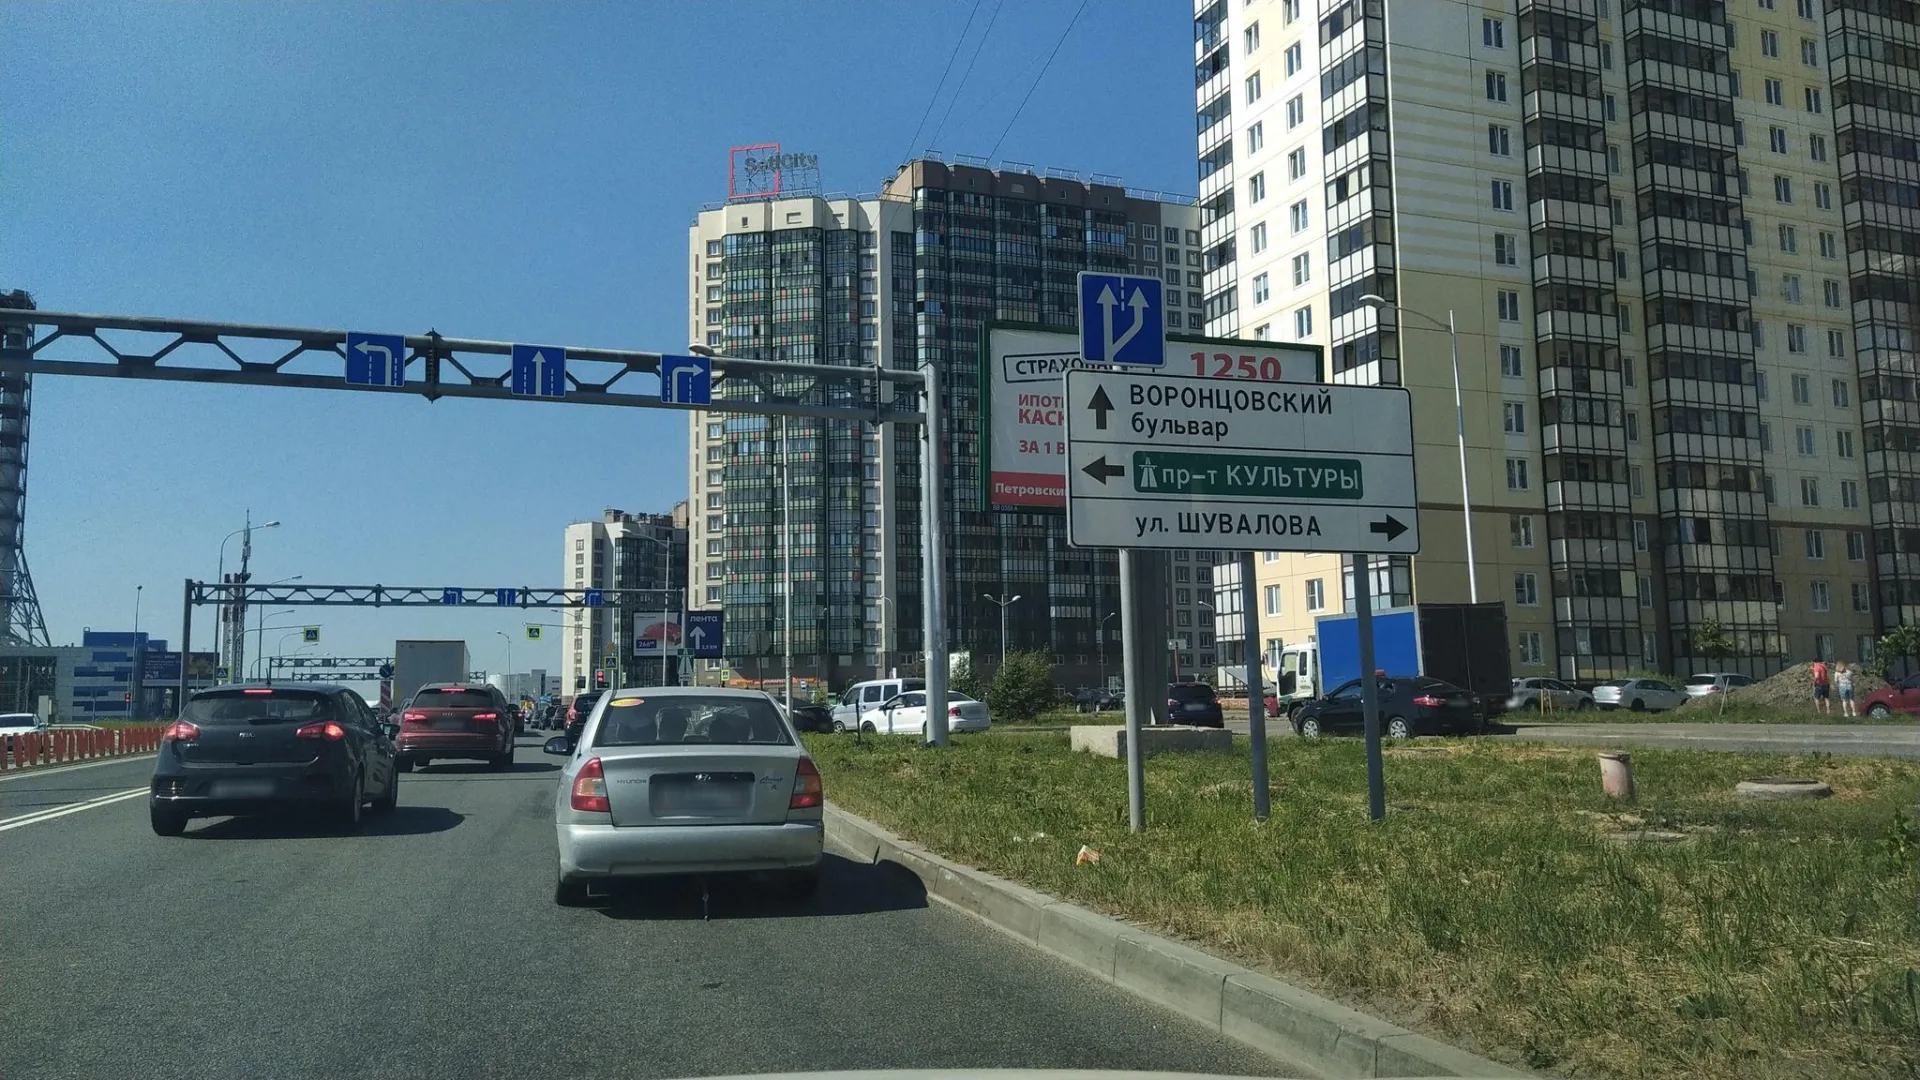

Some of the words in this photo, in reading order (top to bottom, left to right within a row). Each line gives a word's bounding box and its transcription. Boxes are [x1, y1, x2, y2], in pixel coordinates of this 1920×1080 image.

[1190, 352, 1282, 381] 1250
[1129, 384, 1332, 414] ВОРОНЦОВСКИЙ
[1131, 411, 1229, 441] бульвар
[1019, 440, 1039, 454] ЗА
[1044, 441, 1051, 455] 1
[995, 483, 1067, 497] Петровски
[1162, 467, 1218, 489] пр-т
[1226, 464, 1359, 490] КУЛЬТУРЫ
[1135, 516, 1169, 538] ул.
[1178, 512, 1322, 536] ШУВАЛОВА
